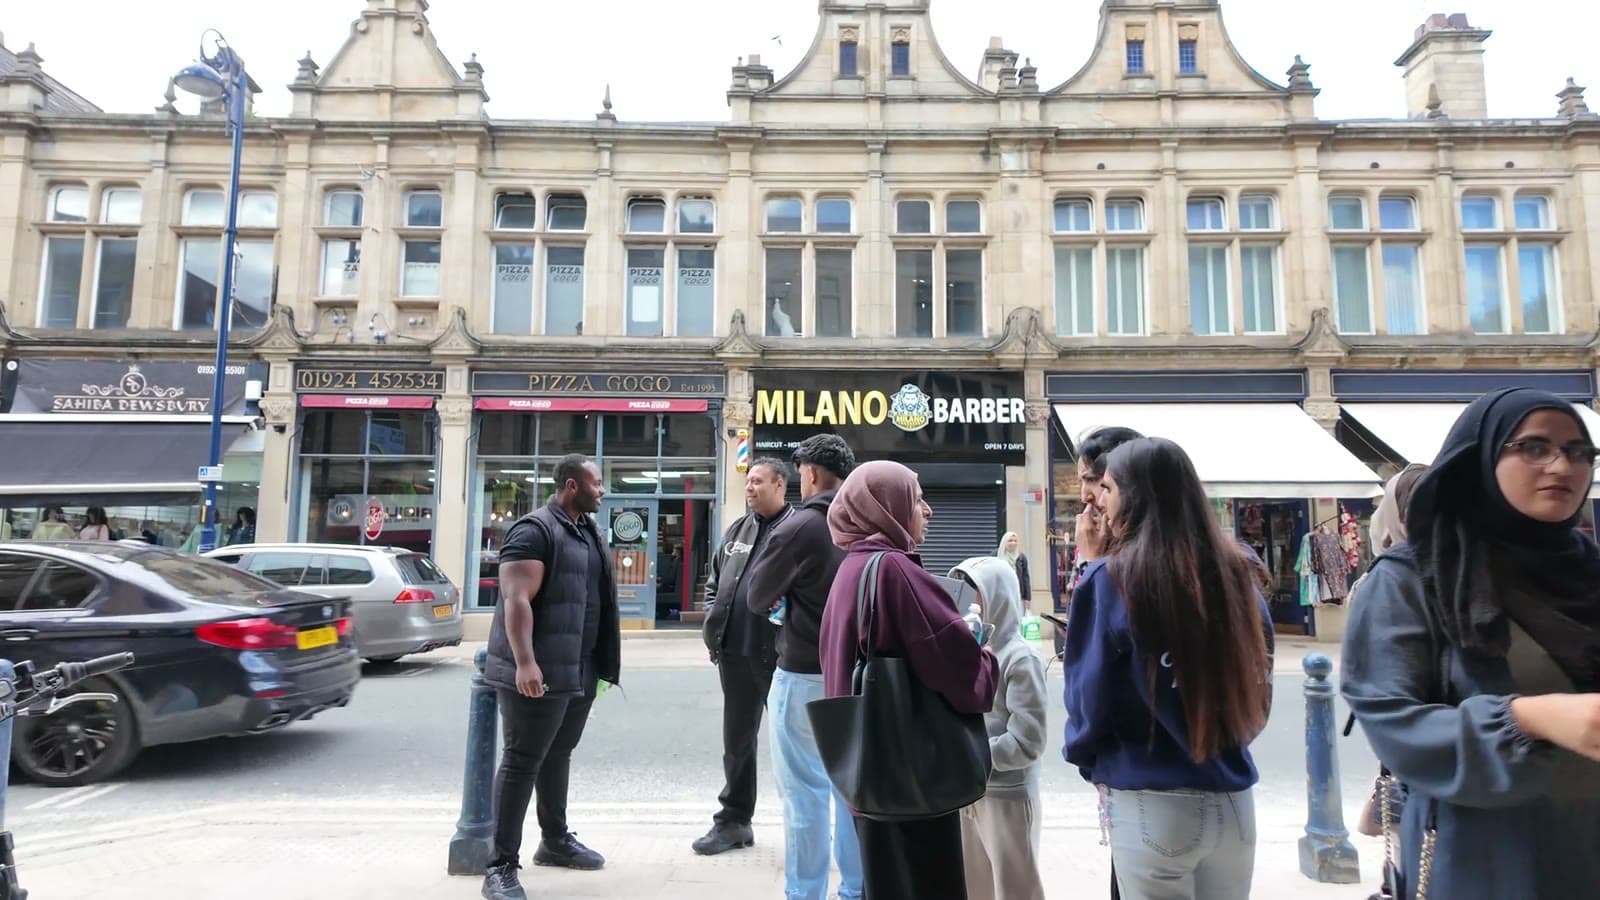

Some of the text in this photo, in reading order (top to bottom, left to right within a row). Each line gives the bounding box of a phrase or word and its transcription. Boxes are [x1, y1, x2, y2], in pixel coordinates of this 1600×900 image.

[499, 266, 530, 274] PIZZA
[550, 266, 581, 274] PIZZA
[630, 269, 661, 277] PIZZA
[302, 373, 438, 389] 01924 452534
[528, 375, 595, 392] PIZZA
[606, 375, 672, 393] GOGO
[53, 398, 209, 412] SAHIBA DEWSBURY
[756, 389, 887, 426] MILANO
[934, 397, 1026, 424] BARBER
[895, 414, 926, 425] MILANO
[755, 440, 783, 449] HAIRCUT
[984, 442, 1002, 450] OPEN
[618, 520, 640, 533] GOGO
